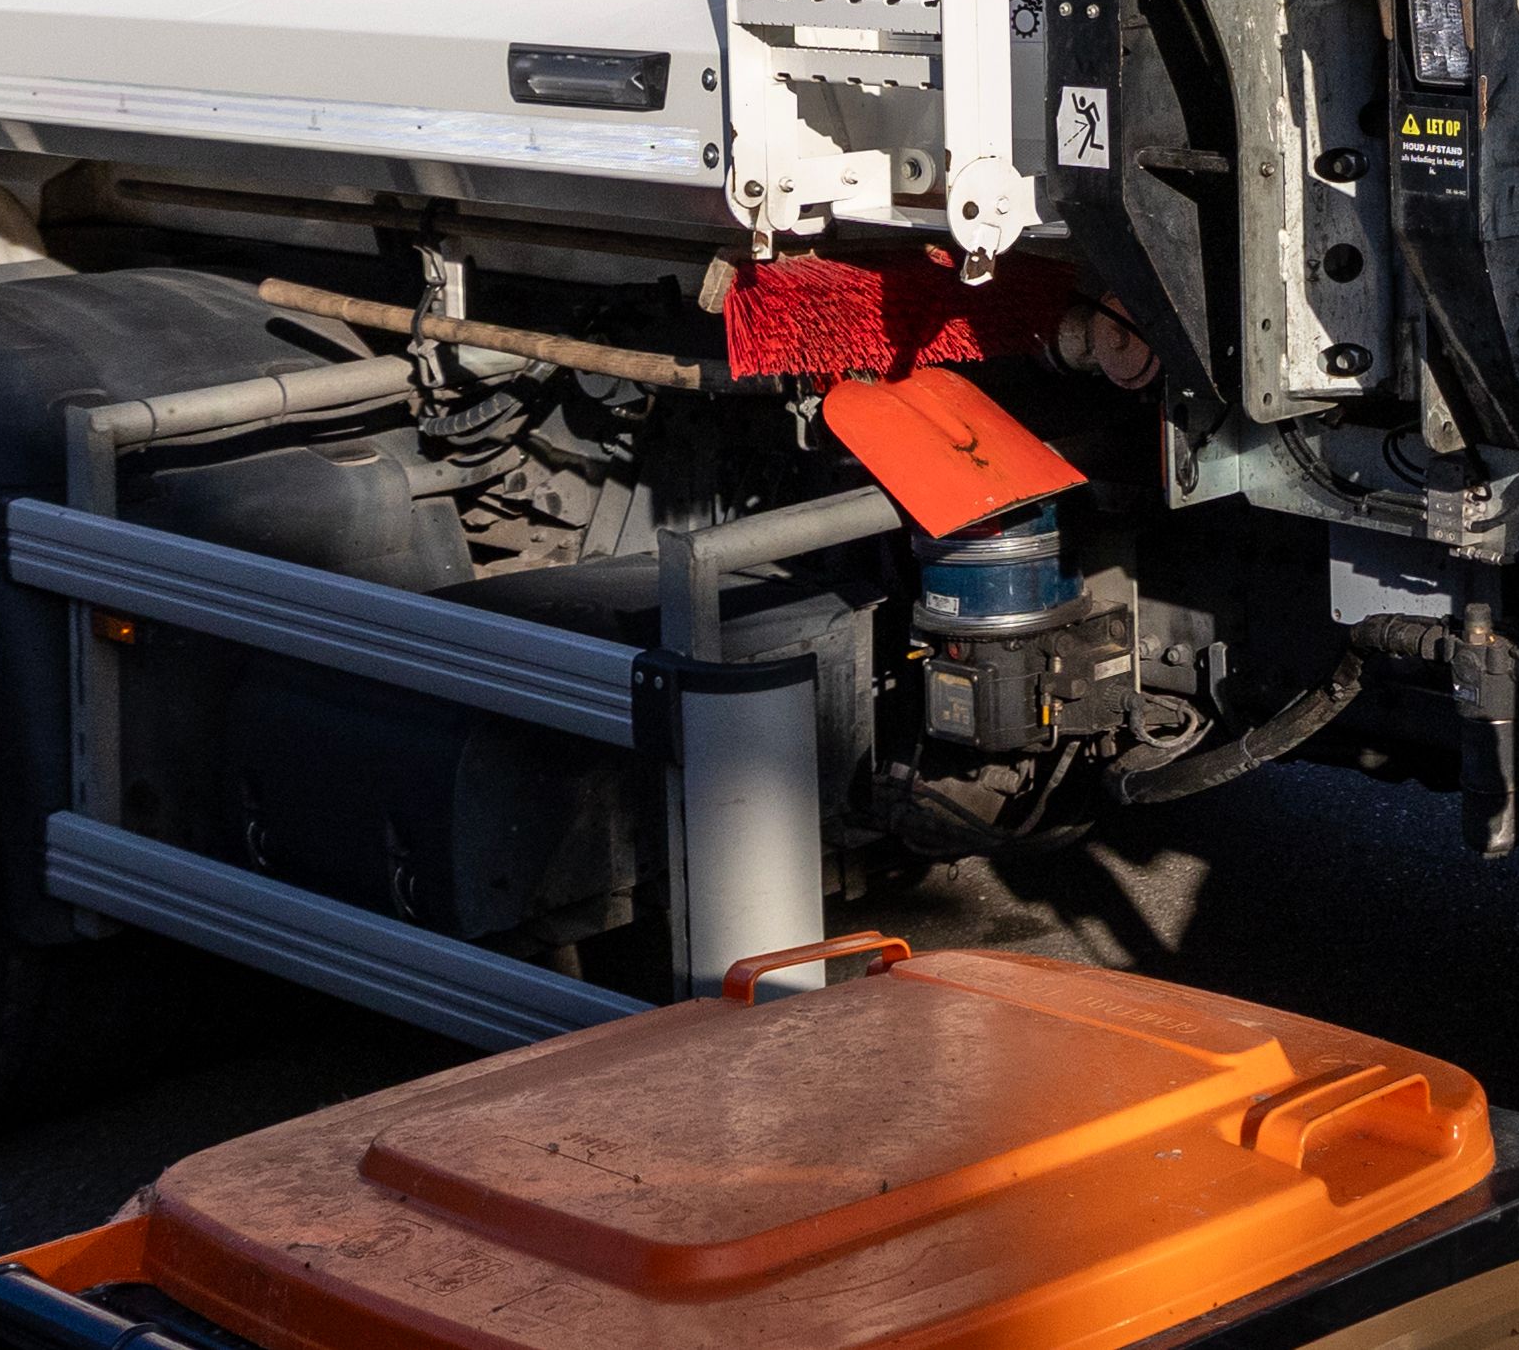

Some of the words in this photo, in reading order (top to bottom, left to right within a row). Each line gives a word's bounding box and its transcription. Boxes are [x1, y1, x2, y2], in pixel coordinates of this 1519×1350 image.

[1426, 118, 1444, 135] LET
[1445, 120, 1461, 137] OP
[1402, 141, 1425, 152] HOUD
[1427, 144, 1462, 156] AFSTAND
